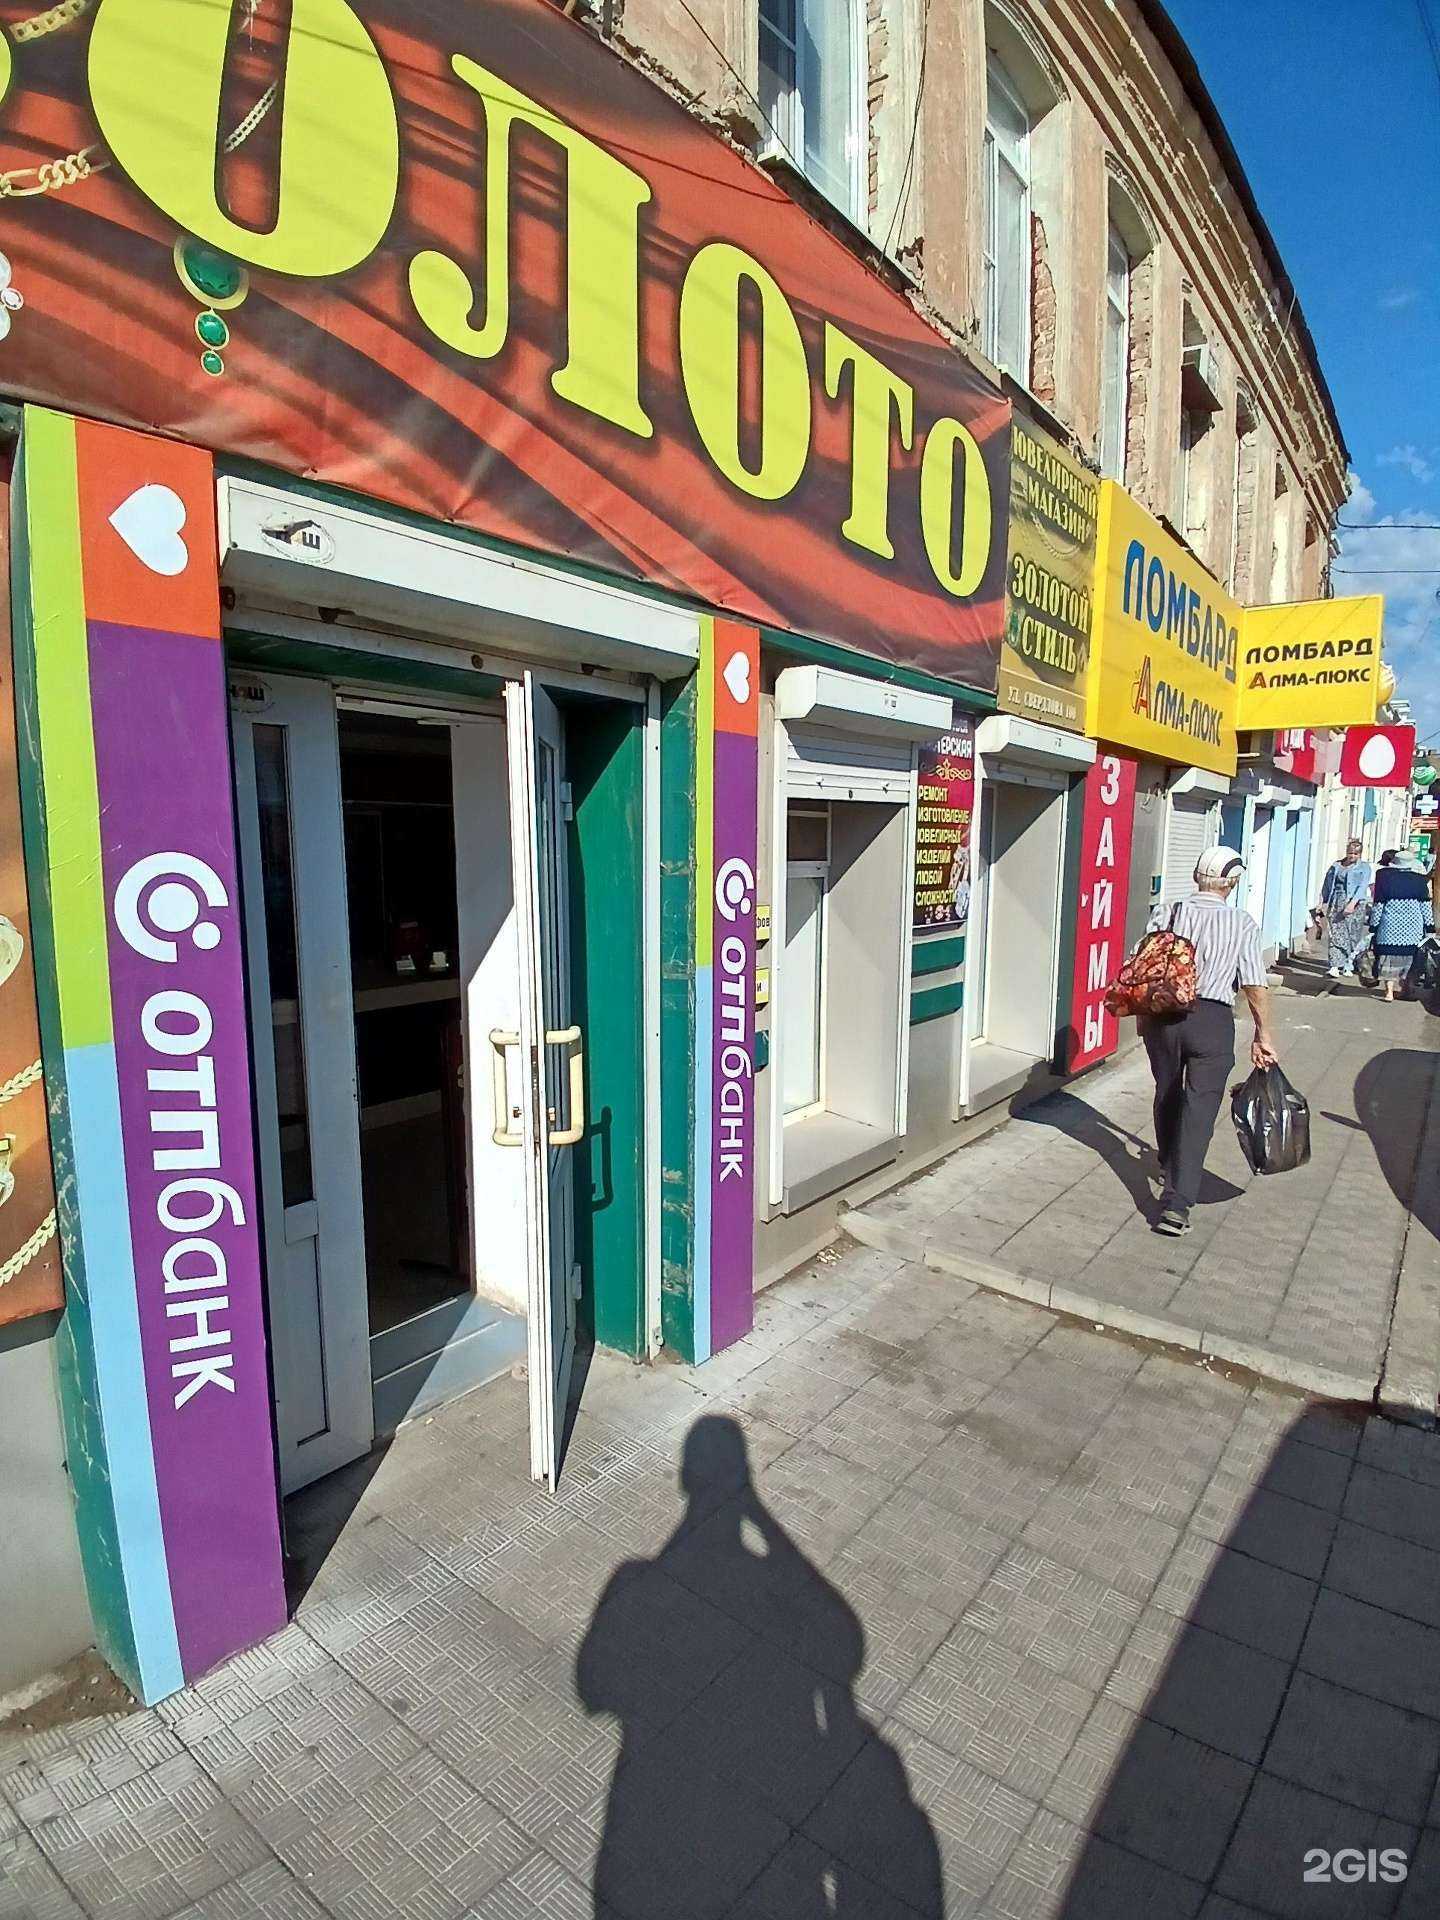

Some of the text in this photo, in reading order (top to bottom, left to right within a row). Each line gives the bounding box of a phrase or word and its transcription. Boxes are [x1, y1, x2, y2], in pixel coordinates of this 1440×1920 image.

[0, 0, 992, 598] ОЛОТО
[1012, 425, 1098, 520] ЮВЕЛИРНЫЙ
[1028, 475, 1086, 543] МАГАЗИН
[1012, 555, 1090, 634] ЗОЛОТОЙ
[1123, 539, 1239, 684] ЛОМБАРД
[1021, 615, 1077, 674] СТИЛЬ
[1245, 638, 1373, 665] ЛОМБАРД
[917, 806, 970, 824] ИЗГОТОВЛЕНИЕ
[918, 785, 949, 802] РЕМОНТ
[915, 866, 943, 885] ЛЮБОЙ
[916, 846, 952, 865] ИЗДЕЛИЙ
[1083, 755, 1121, 1054] ЗАЙМЫ
